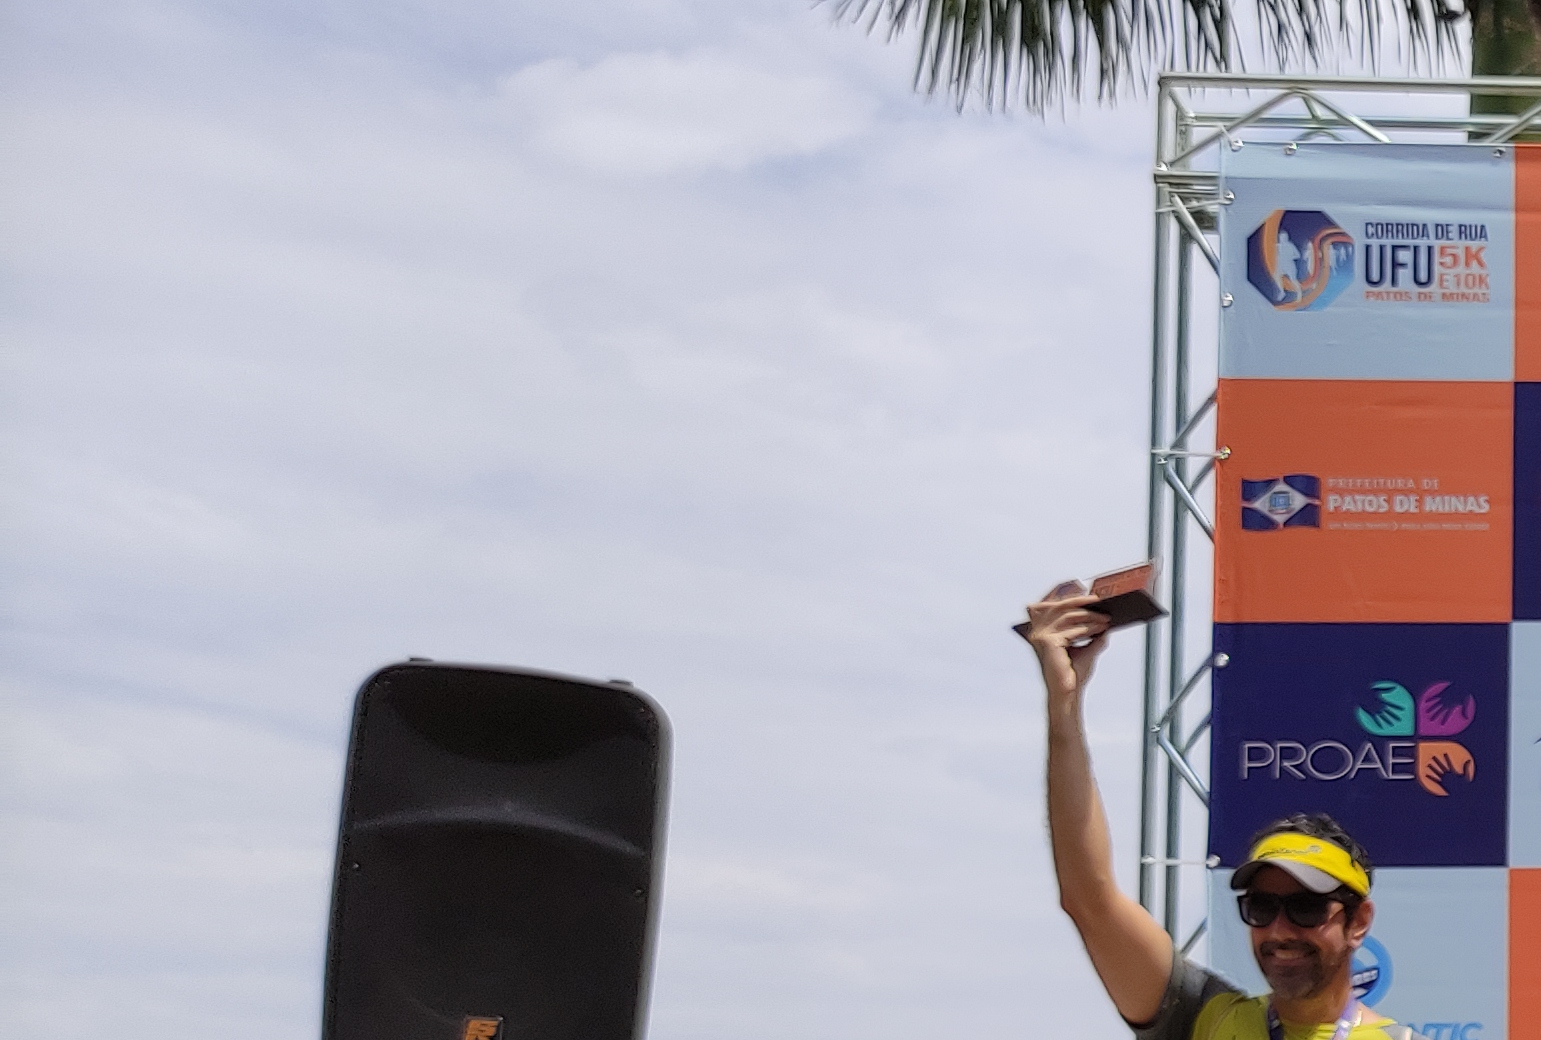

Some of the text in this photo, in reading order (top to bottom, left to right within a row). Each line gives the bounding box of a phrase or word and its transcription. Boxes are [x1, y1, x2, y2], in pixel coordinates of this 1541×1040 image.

[1365, 222, 1488, 241] CORRIDA DE RUA
[1364, 244, 1486, 287] UFU 5K
[1365, 290, 1490, 303] PATOS DE MINAS
[1327, 478, 1440, 490] PREFEITURA DE
[1327, 495, 1490, 513] PATOS DE MINAS
[1239, 741, 1415, 780] PROAE
